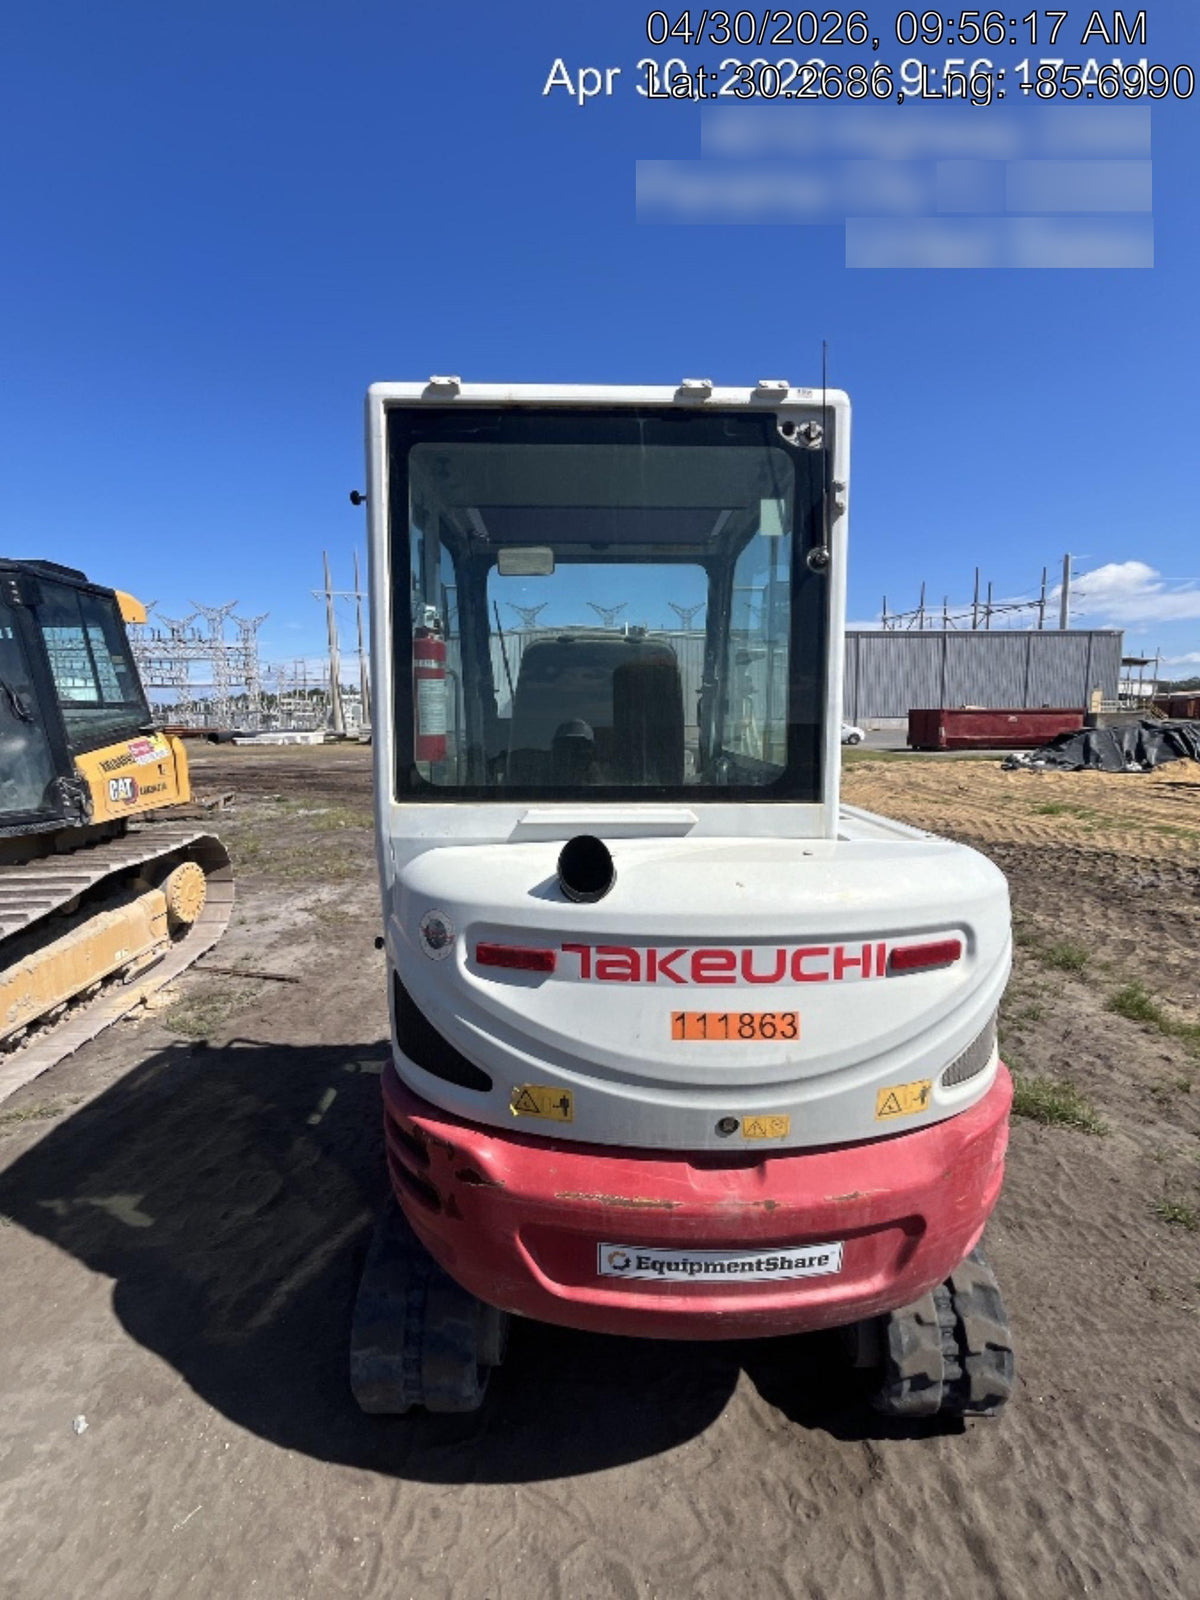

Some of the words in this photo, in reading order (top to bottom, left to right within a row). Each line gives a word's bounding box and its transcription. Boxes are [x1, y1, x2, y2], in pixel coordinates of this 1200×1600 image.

[108, 776, 133, 802] CAT
[674, 1012, 798, 1040] 111863
[635, 1253, 829, 1277] EquipmentShare
